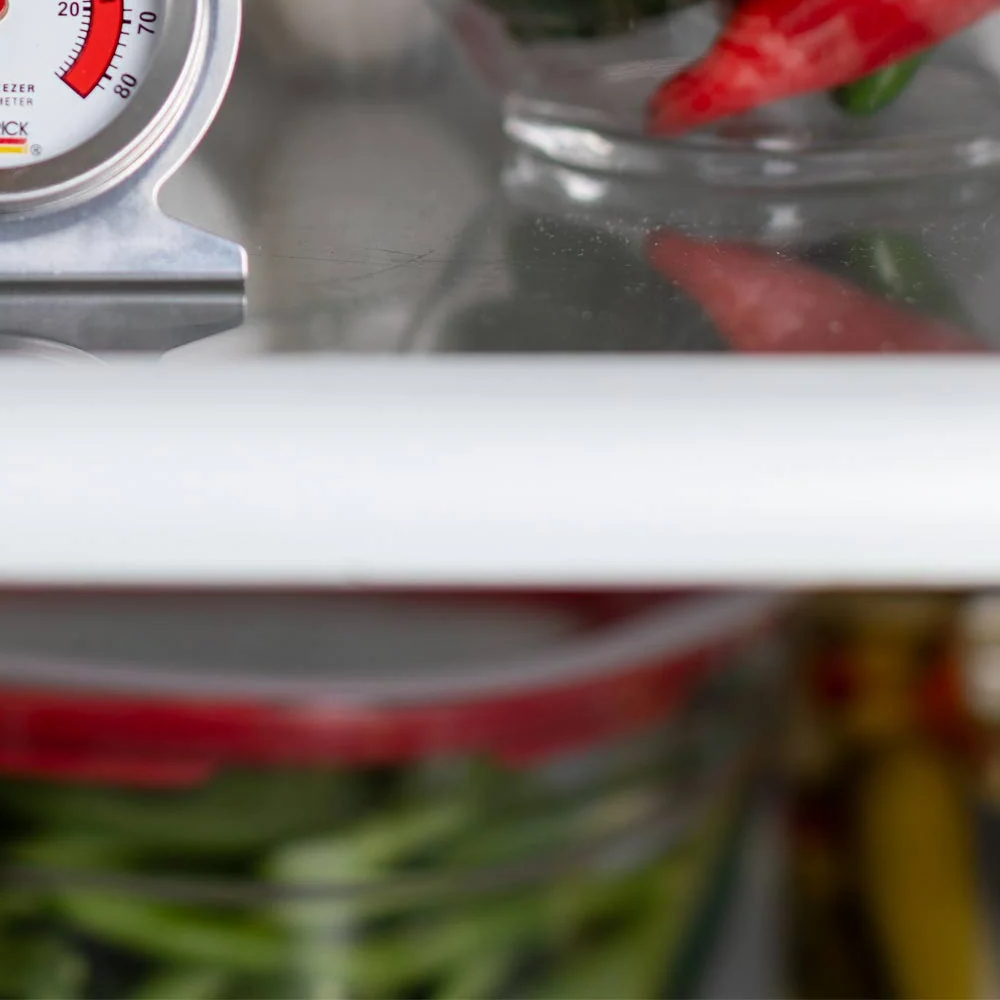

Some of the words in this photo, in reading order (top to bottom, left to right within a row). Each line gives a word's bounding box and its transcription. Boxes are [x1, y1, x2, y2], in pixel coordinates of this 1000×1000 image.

[57, 1, 80, 16] 20
[137, 11, 157, 35] 70
[113, 73, 137, 99] 80
